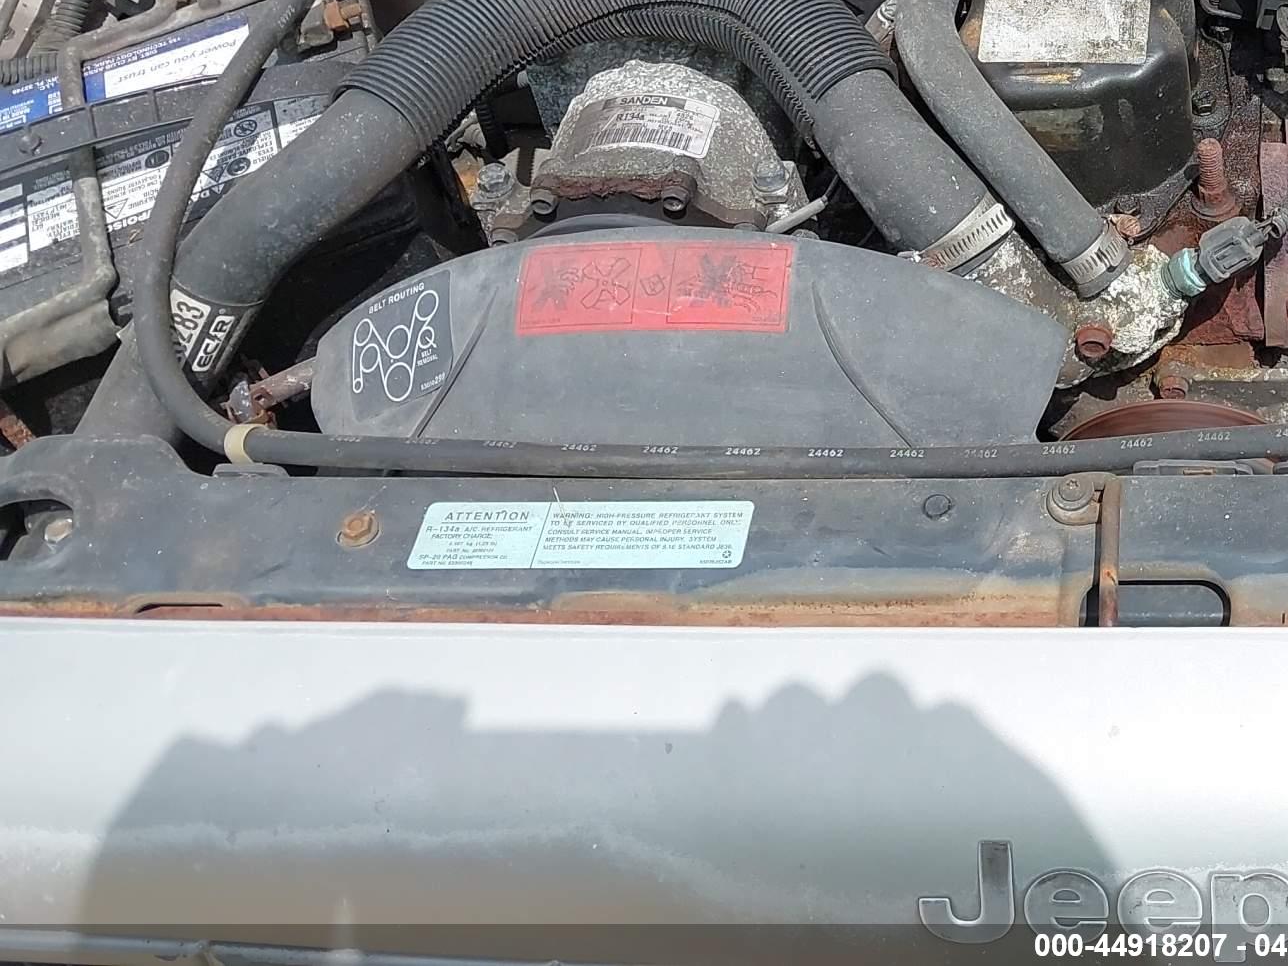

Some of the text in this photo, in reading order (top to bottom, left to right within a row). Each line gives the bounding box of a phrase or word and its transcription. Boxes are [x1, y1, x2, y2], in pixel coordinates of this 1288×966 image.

[620, 96, 668, 105] SANDEN
[368, 282, 425, 314] BELT ROUTING
[560, 443, 597, 452] 24462
[1120, 438, 1154, 450] 24462
[642, 446, 679, 455] 24462
[725, 447, 761, 457] 24462
[808, 448, 844, 458] 24462
[889, 449, 925, 458] 24462
[1042, 444, 1076, 456] 24462
[445, 510, 530, 521] ATTENTION
[426, 525, 460, 533] R-134a
